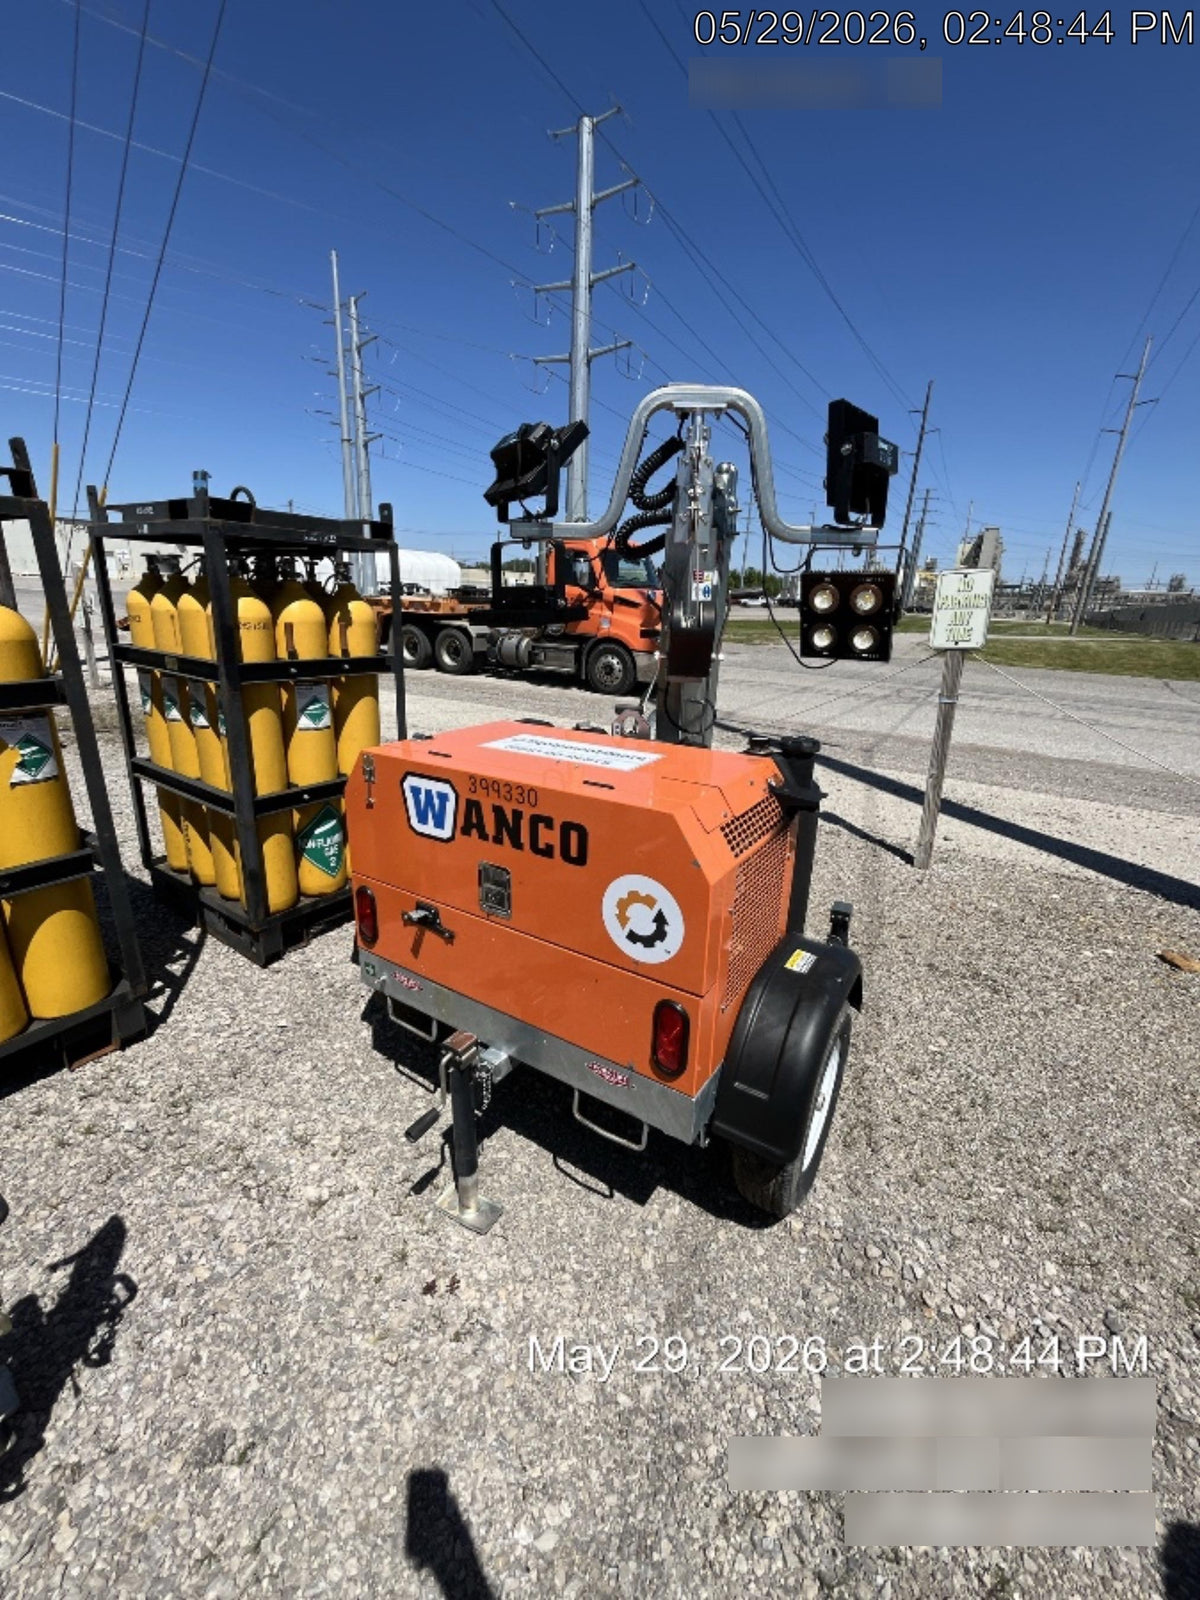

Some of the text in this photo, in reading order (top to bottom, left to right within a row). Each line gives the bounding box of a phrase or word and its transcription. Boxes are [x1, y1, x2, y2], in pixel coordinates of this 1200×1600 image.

[957, 576, 975, 592] NO
[937, 593, 987, 610] PARKING
[947, 611, 973, 626] ANY
[945, 627, 973, 642] TIME
[468, 775, 538, 808] 399330
[409, 784, 589, 866] WANCO
